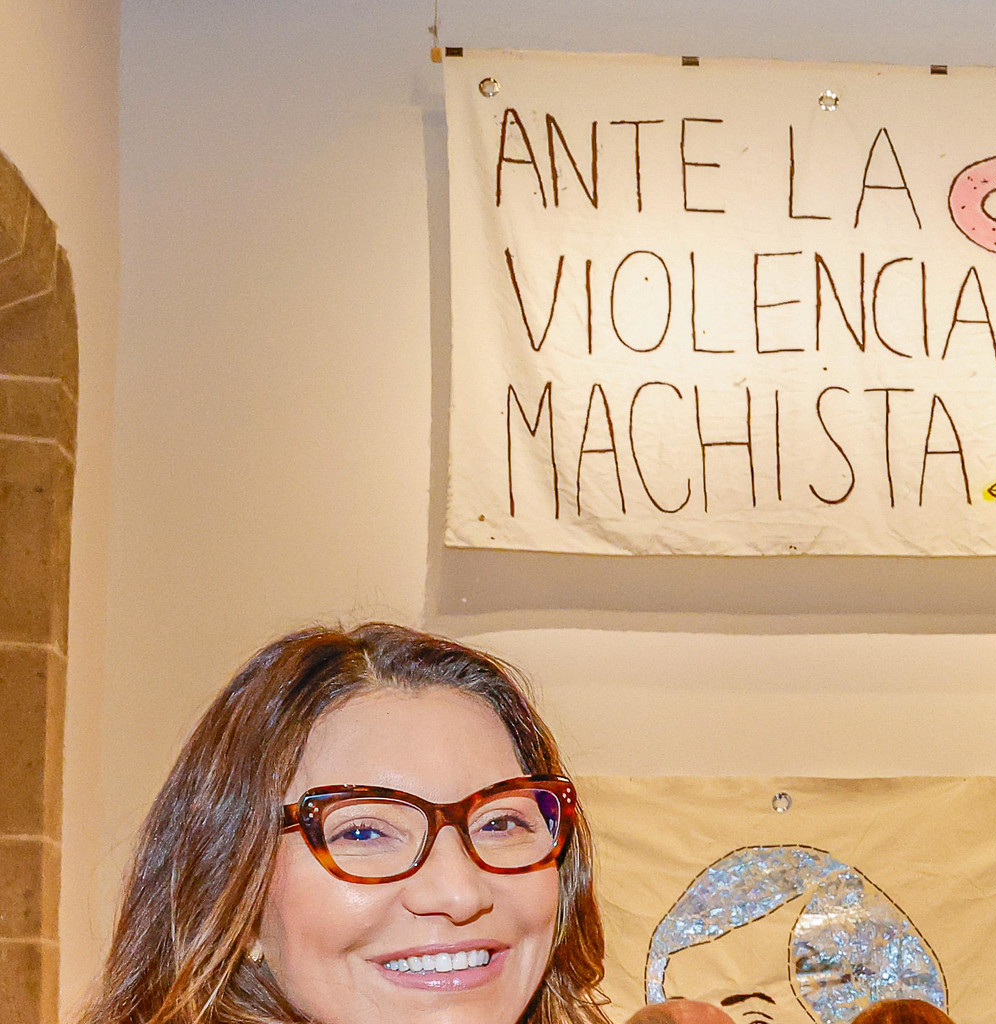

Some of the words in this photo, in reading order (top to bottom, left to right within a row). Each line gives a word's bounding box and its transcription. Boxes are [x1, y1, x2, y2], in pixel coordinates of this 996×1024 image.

[496, 108, 726, 213] ANTE
[789, 125, 922, 230] LA
[507, 380, 973, 520] MACHISTA
